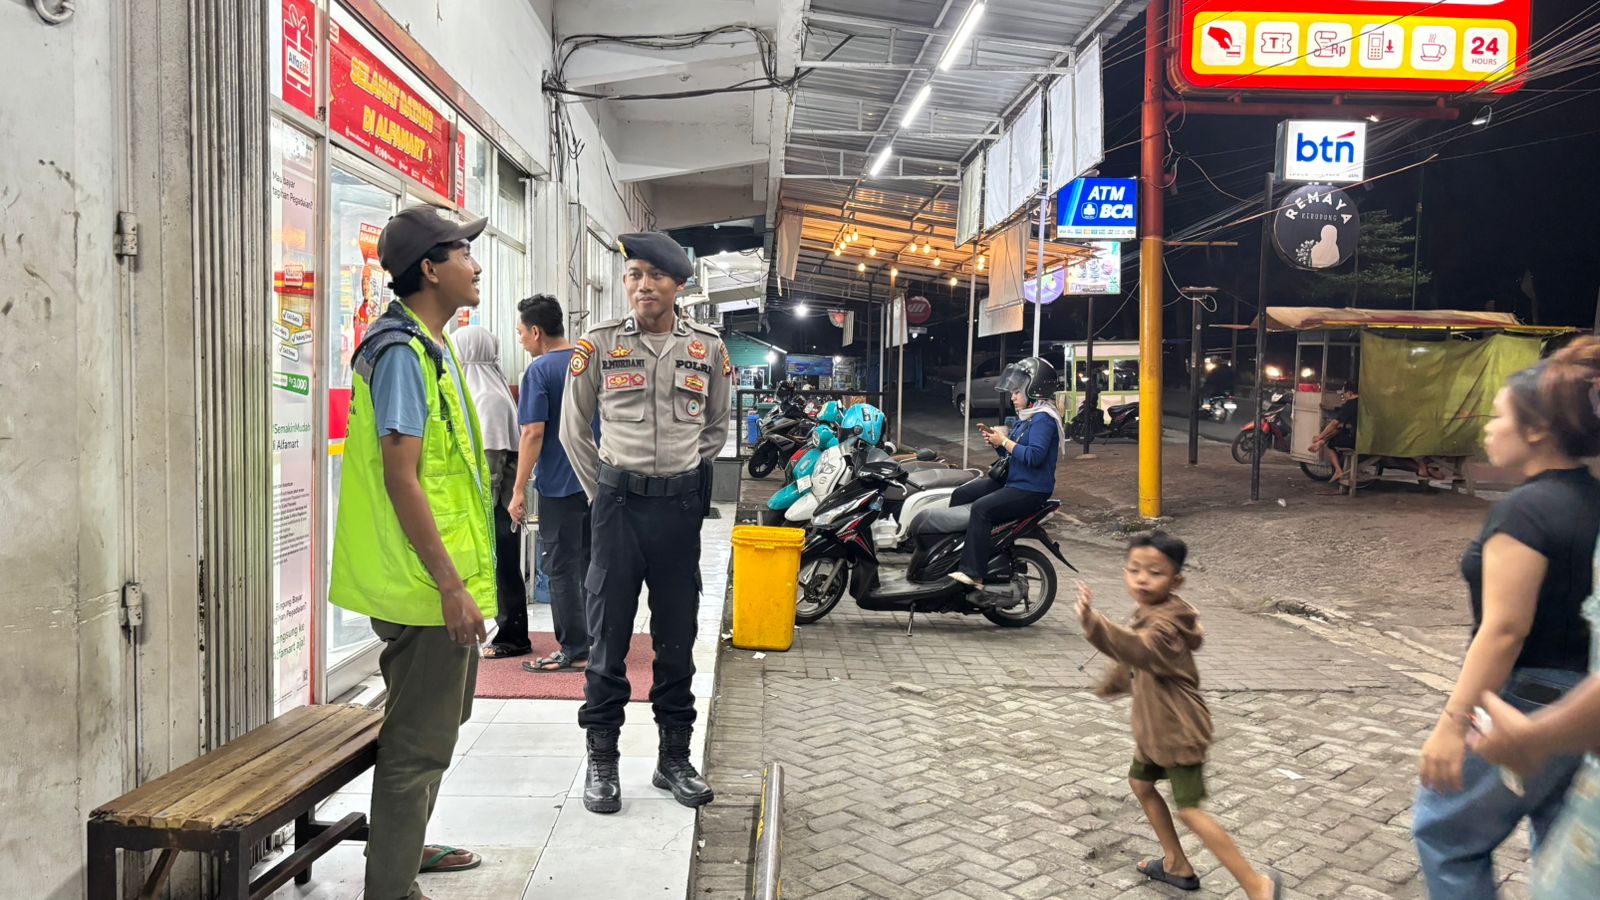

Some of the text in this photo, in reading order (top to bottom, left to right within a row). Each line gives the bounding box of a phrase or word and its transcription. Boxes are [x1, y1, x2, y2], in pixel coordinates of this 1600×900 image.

[1331, 43, 1346, 57] Rp
[1470, 36, 1499, 56] 24
[1471, 57, 1497, 66] HOURS
[350, 55, 400, 111] SELAMAT
[362, 104, 376, 136] DI
[375, 113, 427, 163] ALFAMART
[1296, 131, 1355, 163] btn
[1087, 185, 1126, 201] ATM
[1099, 203, 1134, 219] BCA
[1285, 191, 1353, 225] REMAYA
[1301, 212, 1338, 222] KERUDUNG
[675, 359, 712, 375] POLRI
[272, 421, 311, 434] SemakinMudah
[276, 439, 299, 450] Alfamart
